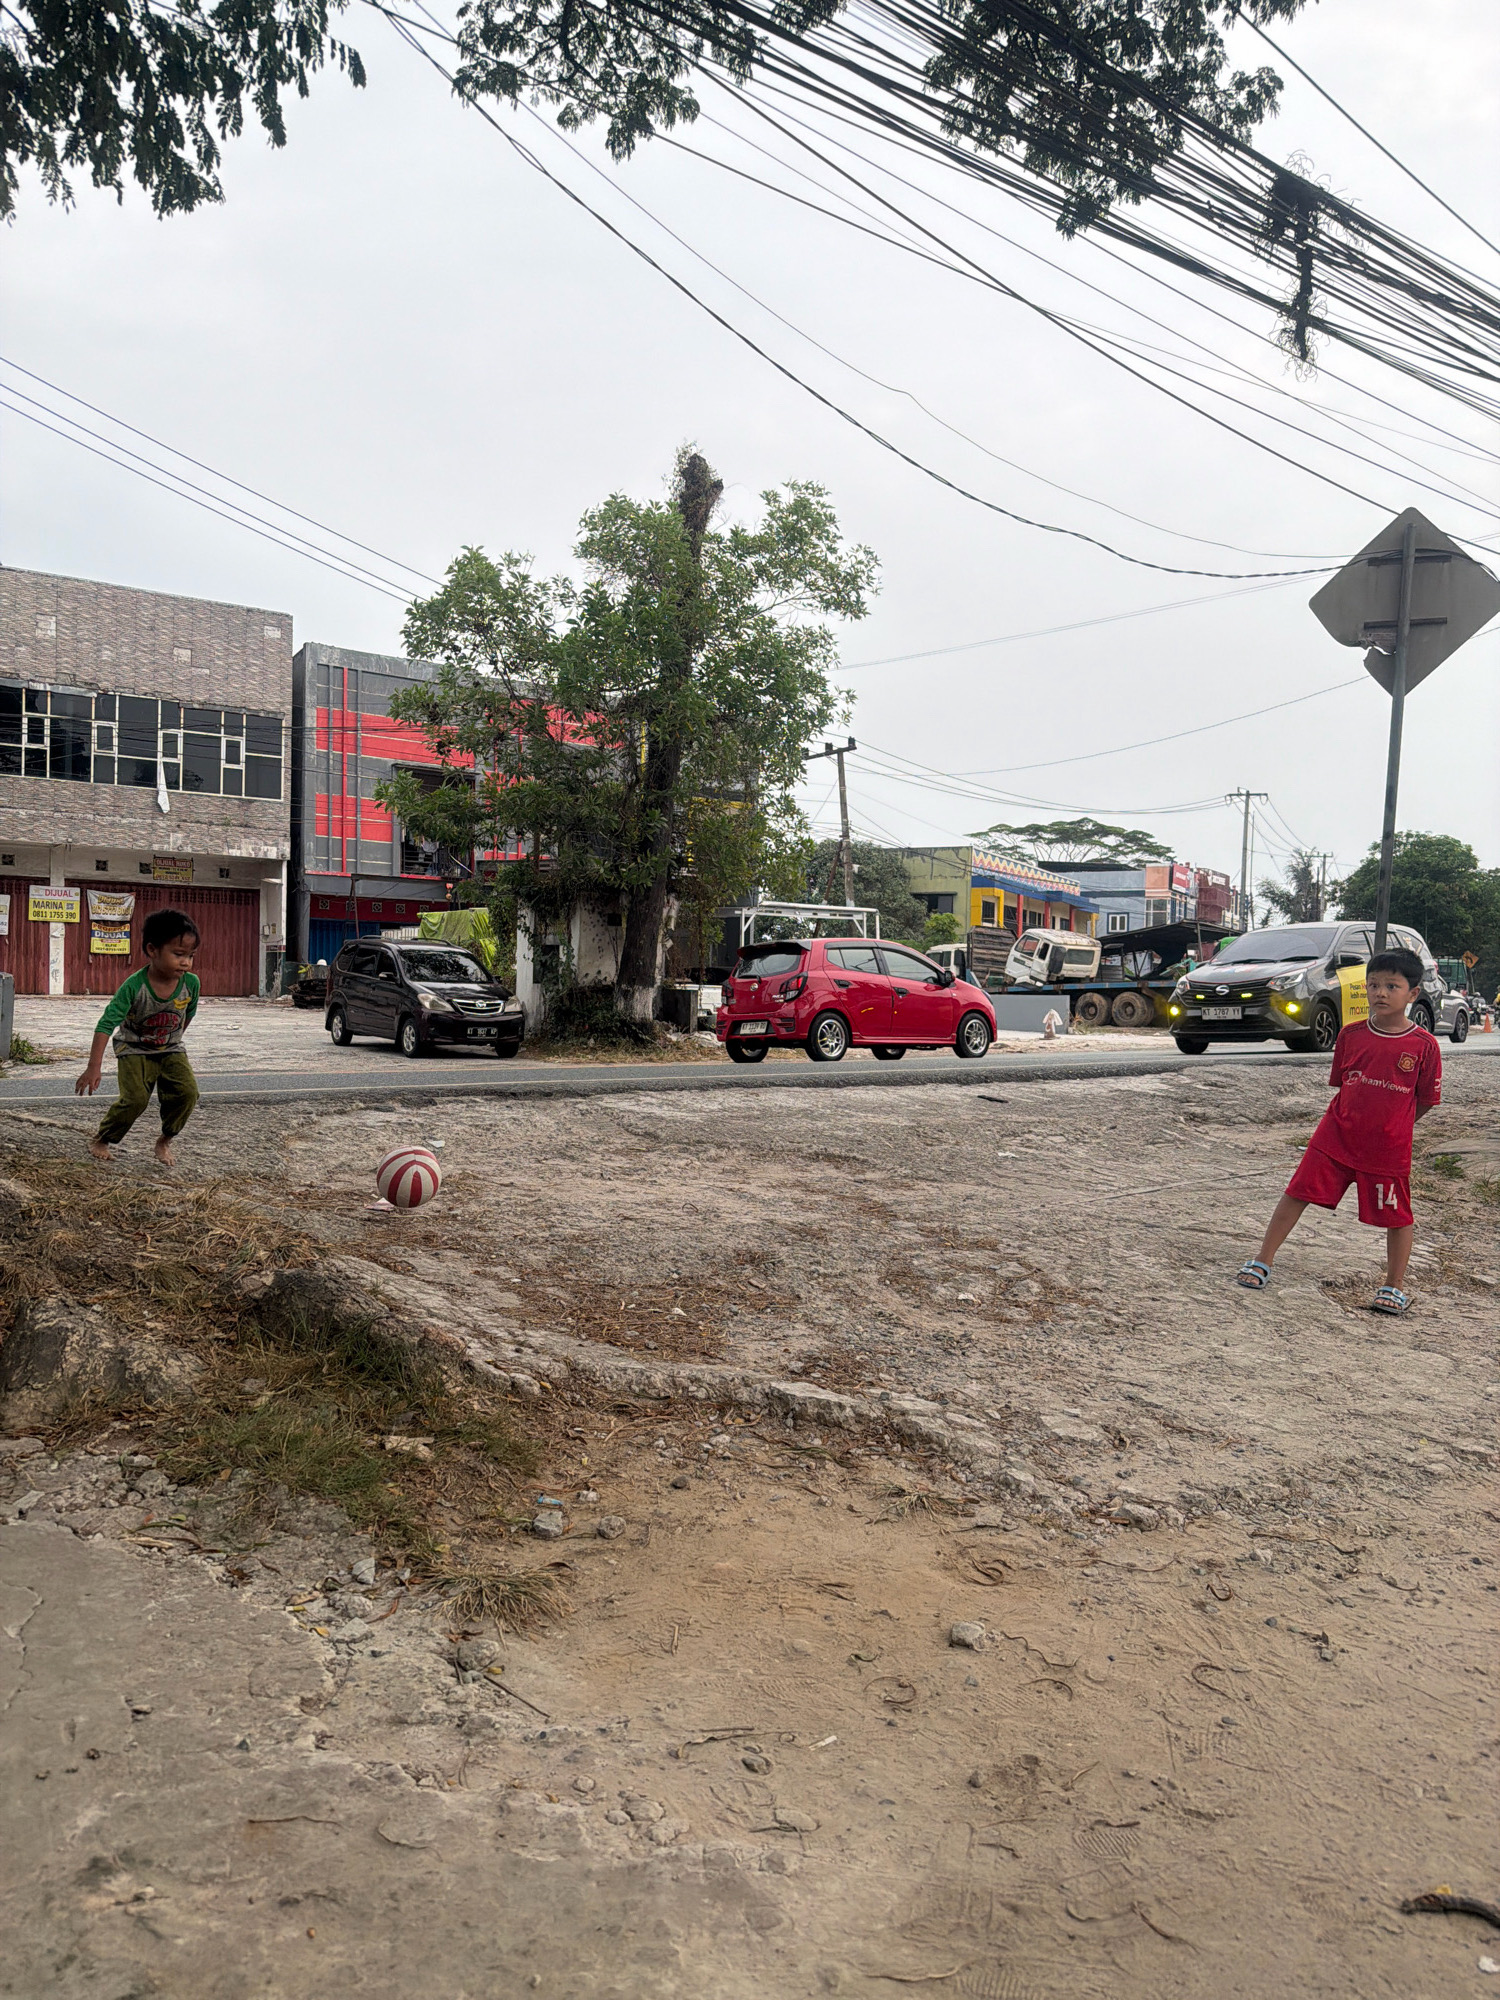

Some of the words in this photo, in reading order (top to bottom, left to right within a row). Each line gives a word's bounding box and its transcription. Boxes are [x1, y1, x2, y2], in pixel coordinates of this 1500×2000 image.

[45, 889, 73, 897] DIJUAL
[32, 900, 63, 910] MARINA
[32, 910, 47, 918] 0811
[1202, 1008, 1211, 1016] KT
[1360, 1075, 1411, 1094] TeamViewer
[1375, 1183, 1398, 1210] 14
